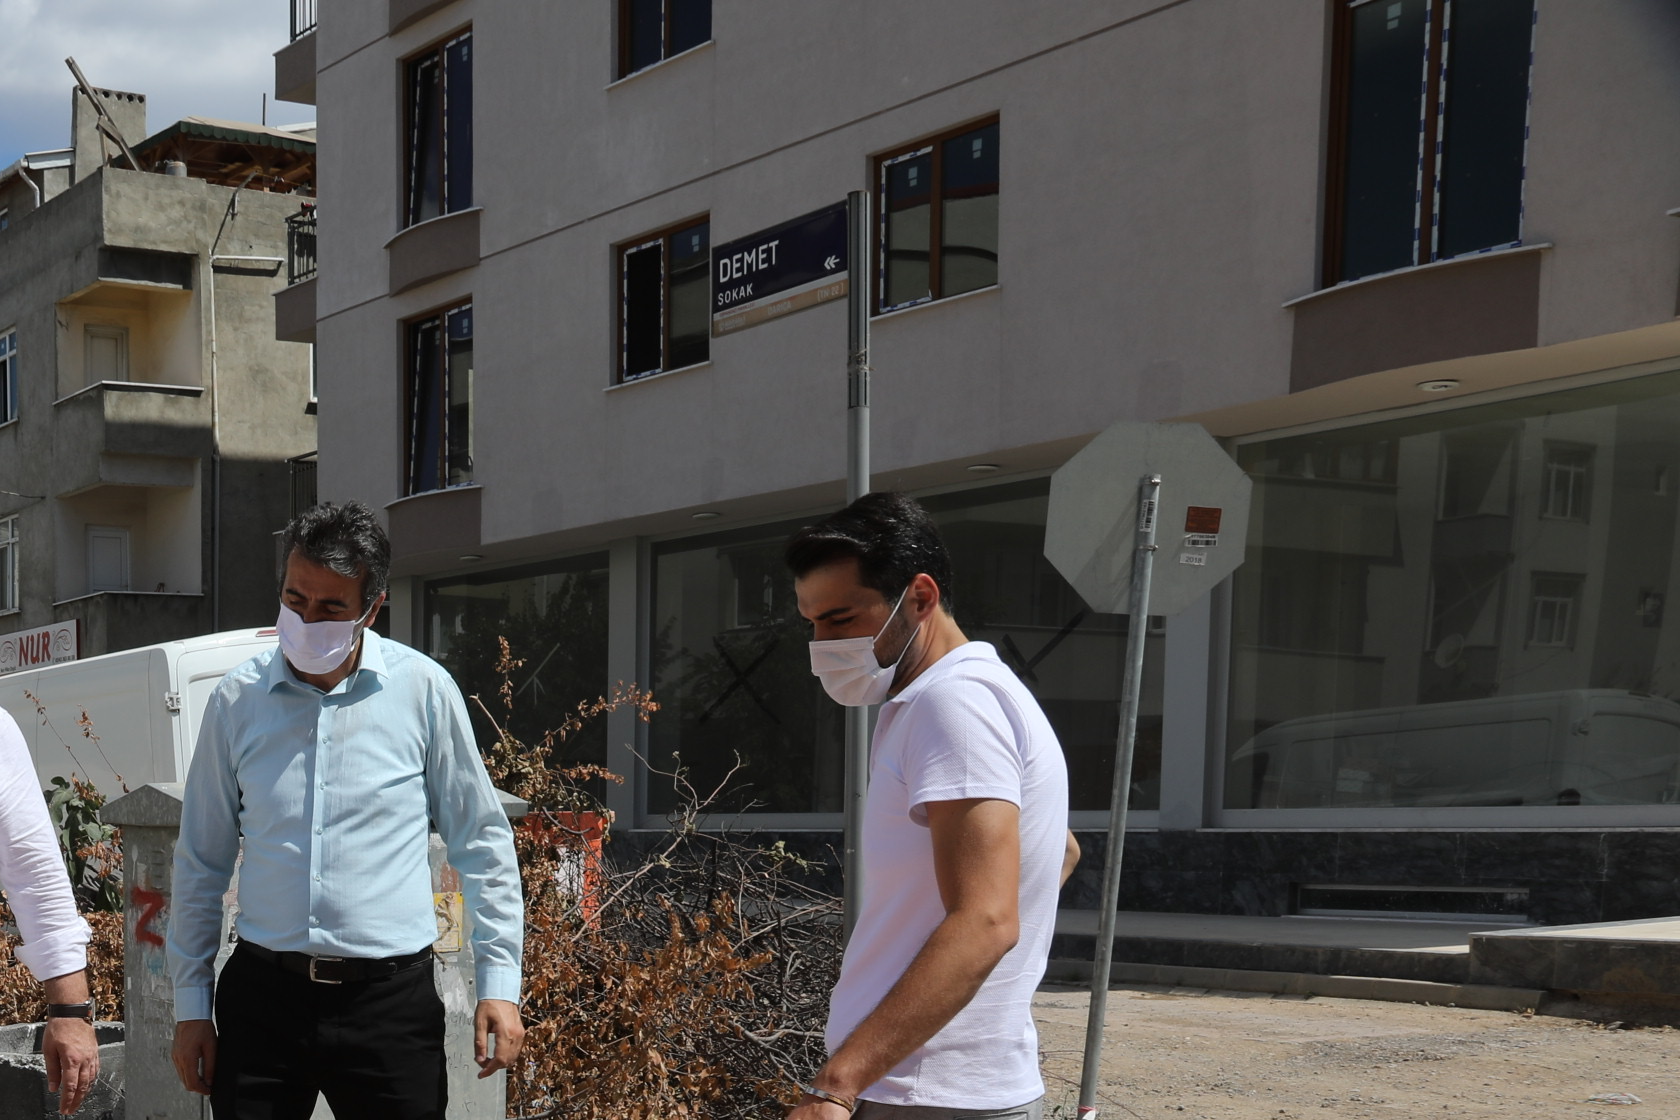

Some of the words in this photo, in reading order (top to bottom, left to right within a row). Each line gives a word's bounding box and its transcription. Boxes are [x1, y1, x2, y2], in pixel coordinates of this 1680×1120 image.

[720, 240, 779, 283] DEMET
[718, 283, 753, 306] SOKAK
[18, 631, 51, 667] NUR
